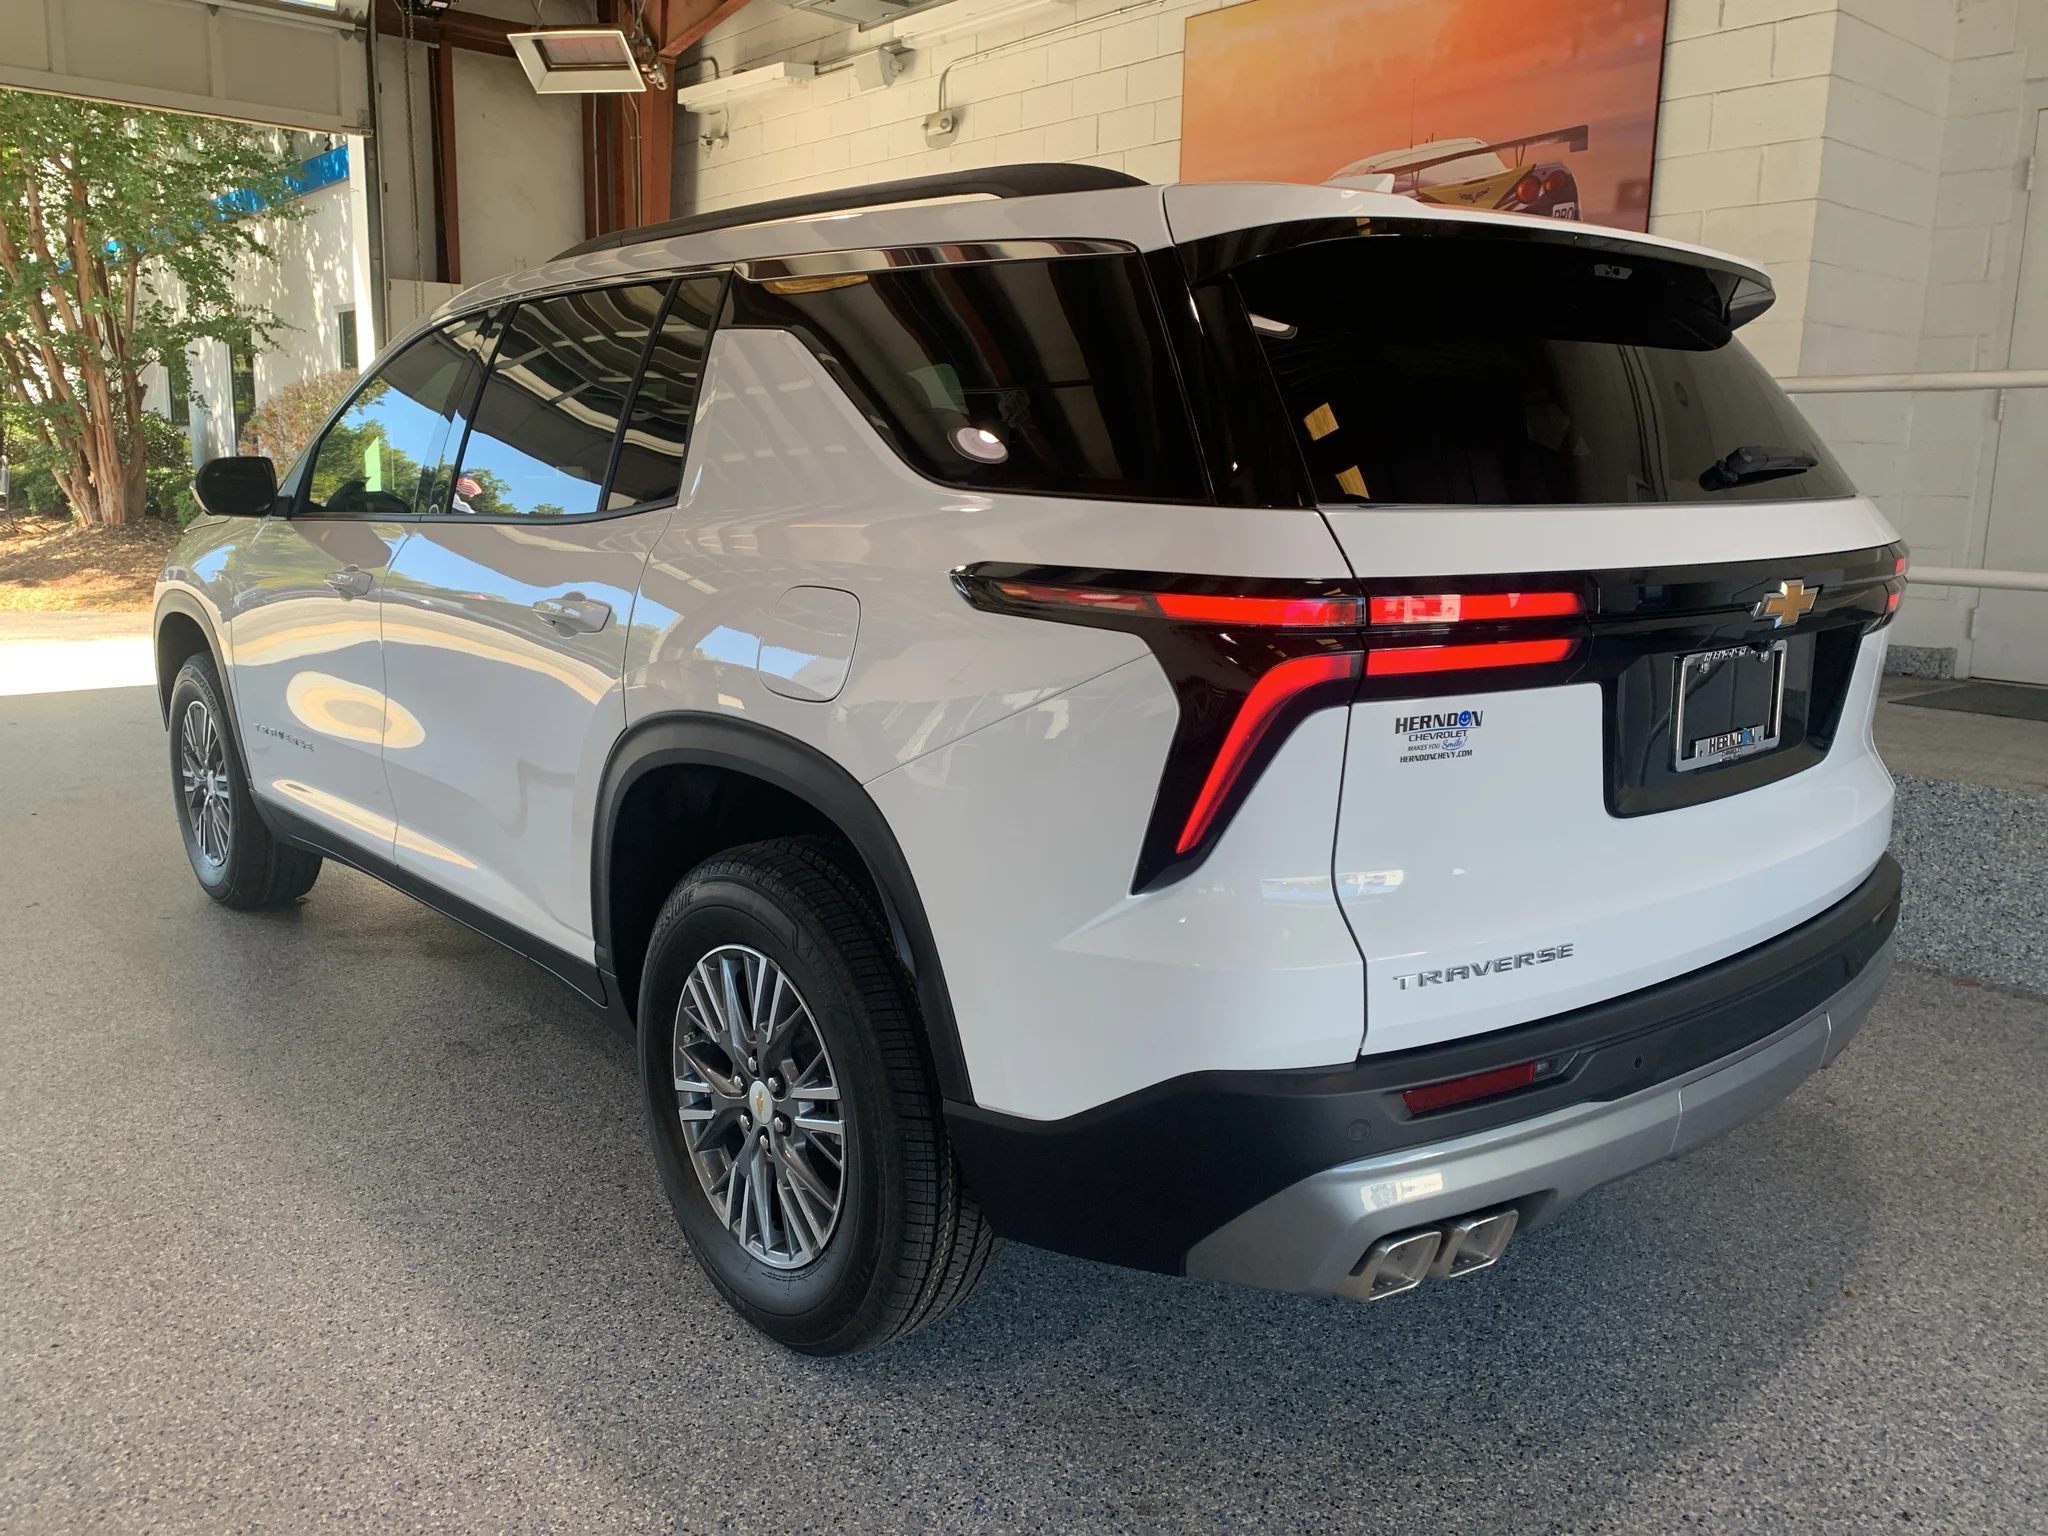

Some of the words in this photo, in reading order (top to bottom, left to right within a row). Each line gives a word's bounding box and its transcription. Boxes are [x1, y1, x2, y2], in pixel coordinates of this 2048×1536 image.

[1395, 710, 1483, 734] HERNDON
[1407, 743, 1428, 752] MAKES
[1429, 742, 1440, 750] YOU
[1408, 729, 1468, 742] CHEVROLET
[1708, 728, 1756, 754] HERNDON
[1400, 749, 1473, 763] HERNDONCHEVY.COM
[645, 888, 693, 977] DGESTONE
[1393, 943, 1574, 990] TRAVERSE
